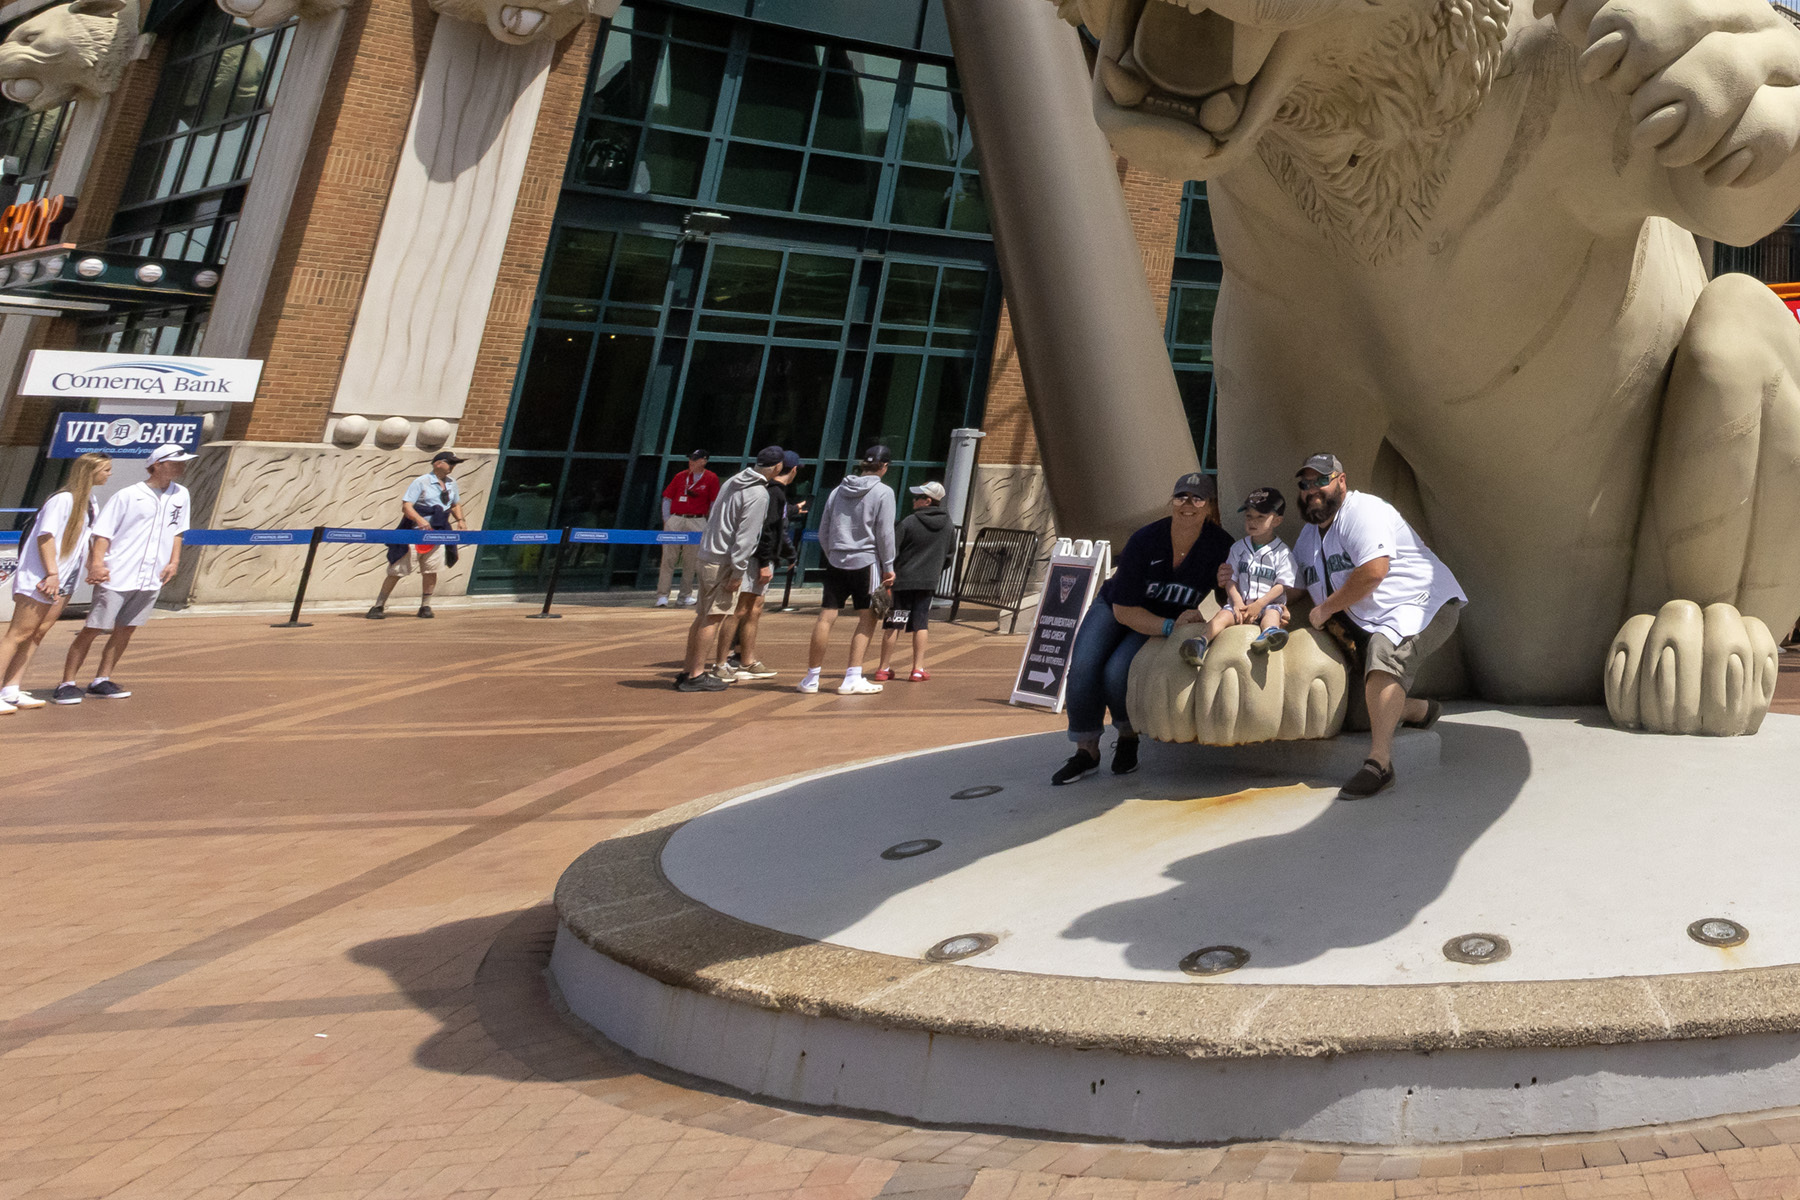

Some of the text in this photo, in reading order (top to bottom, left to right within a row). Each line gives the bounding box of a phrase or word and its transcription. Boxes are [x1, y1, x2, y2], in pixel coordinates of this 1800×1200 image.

[173, 377, 232, 393] Bank
[66, 420, 107, 443] VIP
[138, 422, 197, 445] GATE
[75, 446, 154, 455] comerica.com/you
